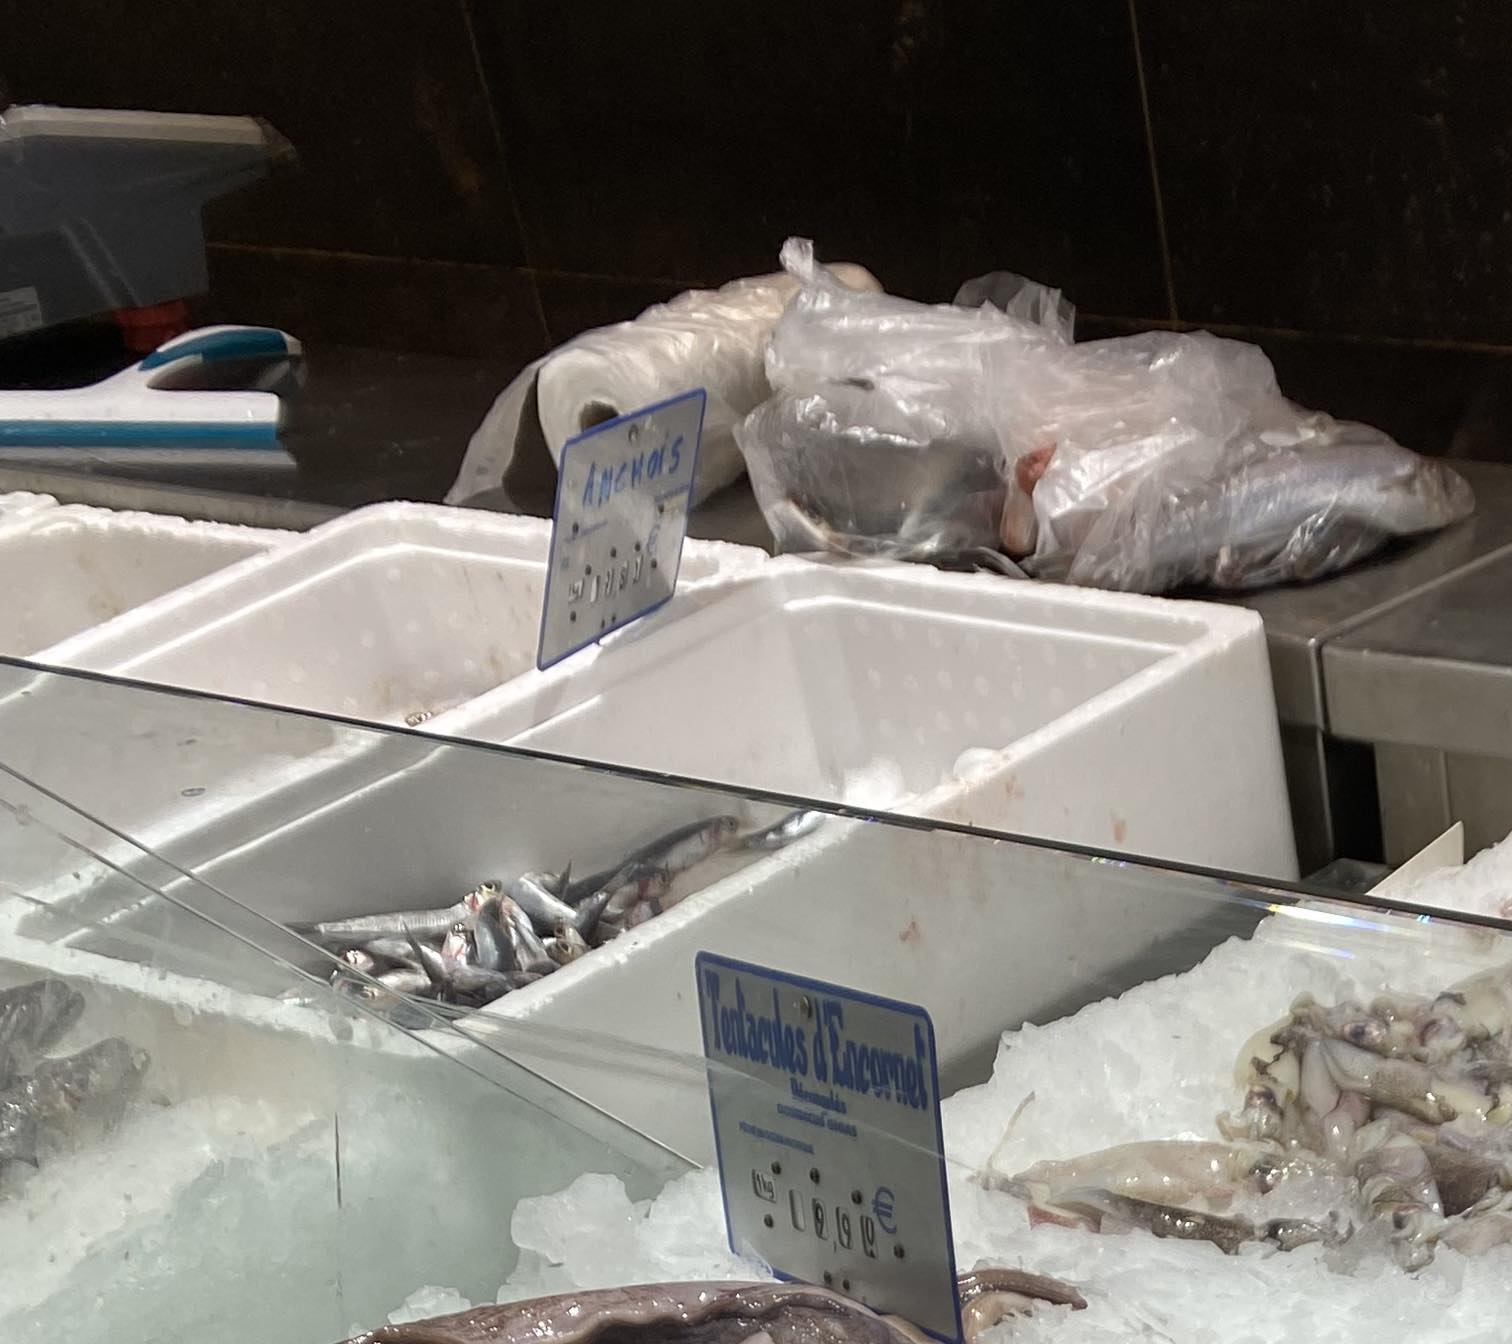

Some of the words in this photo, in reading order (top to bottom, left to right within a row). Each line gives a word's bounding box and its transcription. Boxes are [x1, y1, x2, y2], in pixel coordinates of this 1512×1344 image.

[582, 432, 684, 507] ANCHOIS
[704, 968, 808, 1077] Tentacules
[872, 1186, 897, 1234] €
